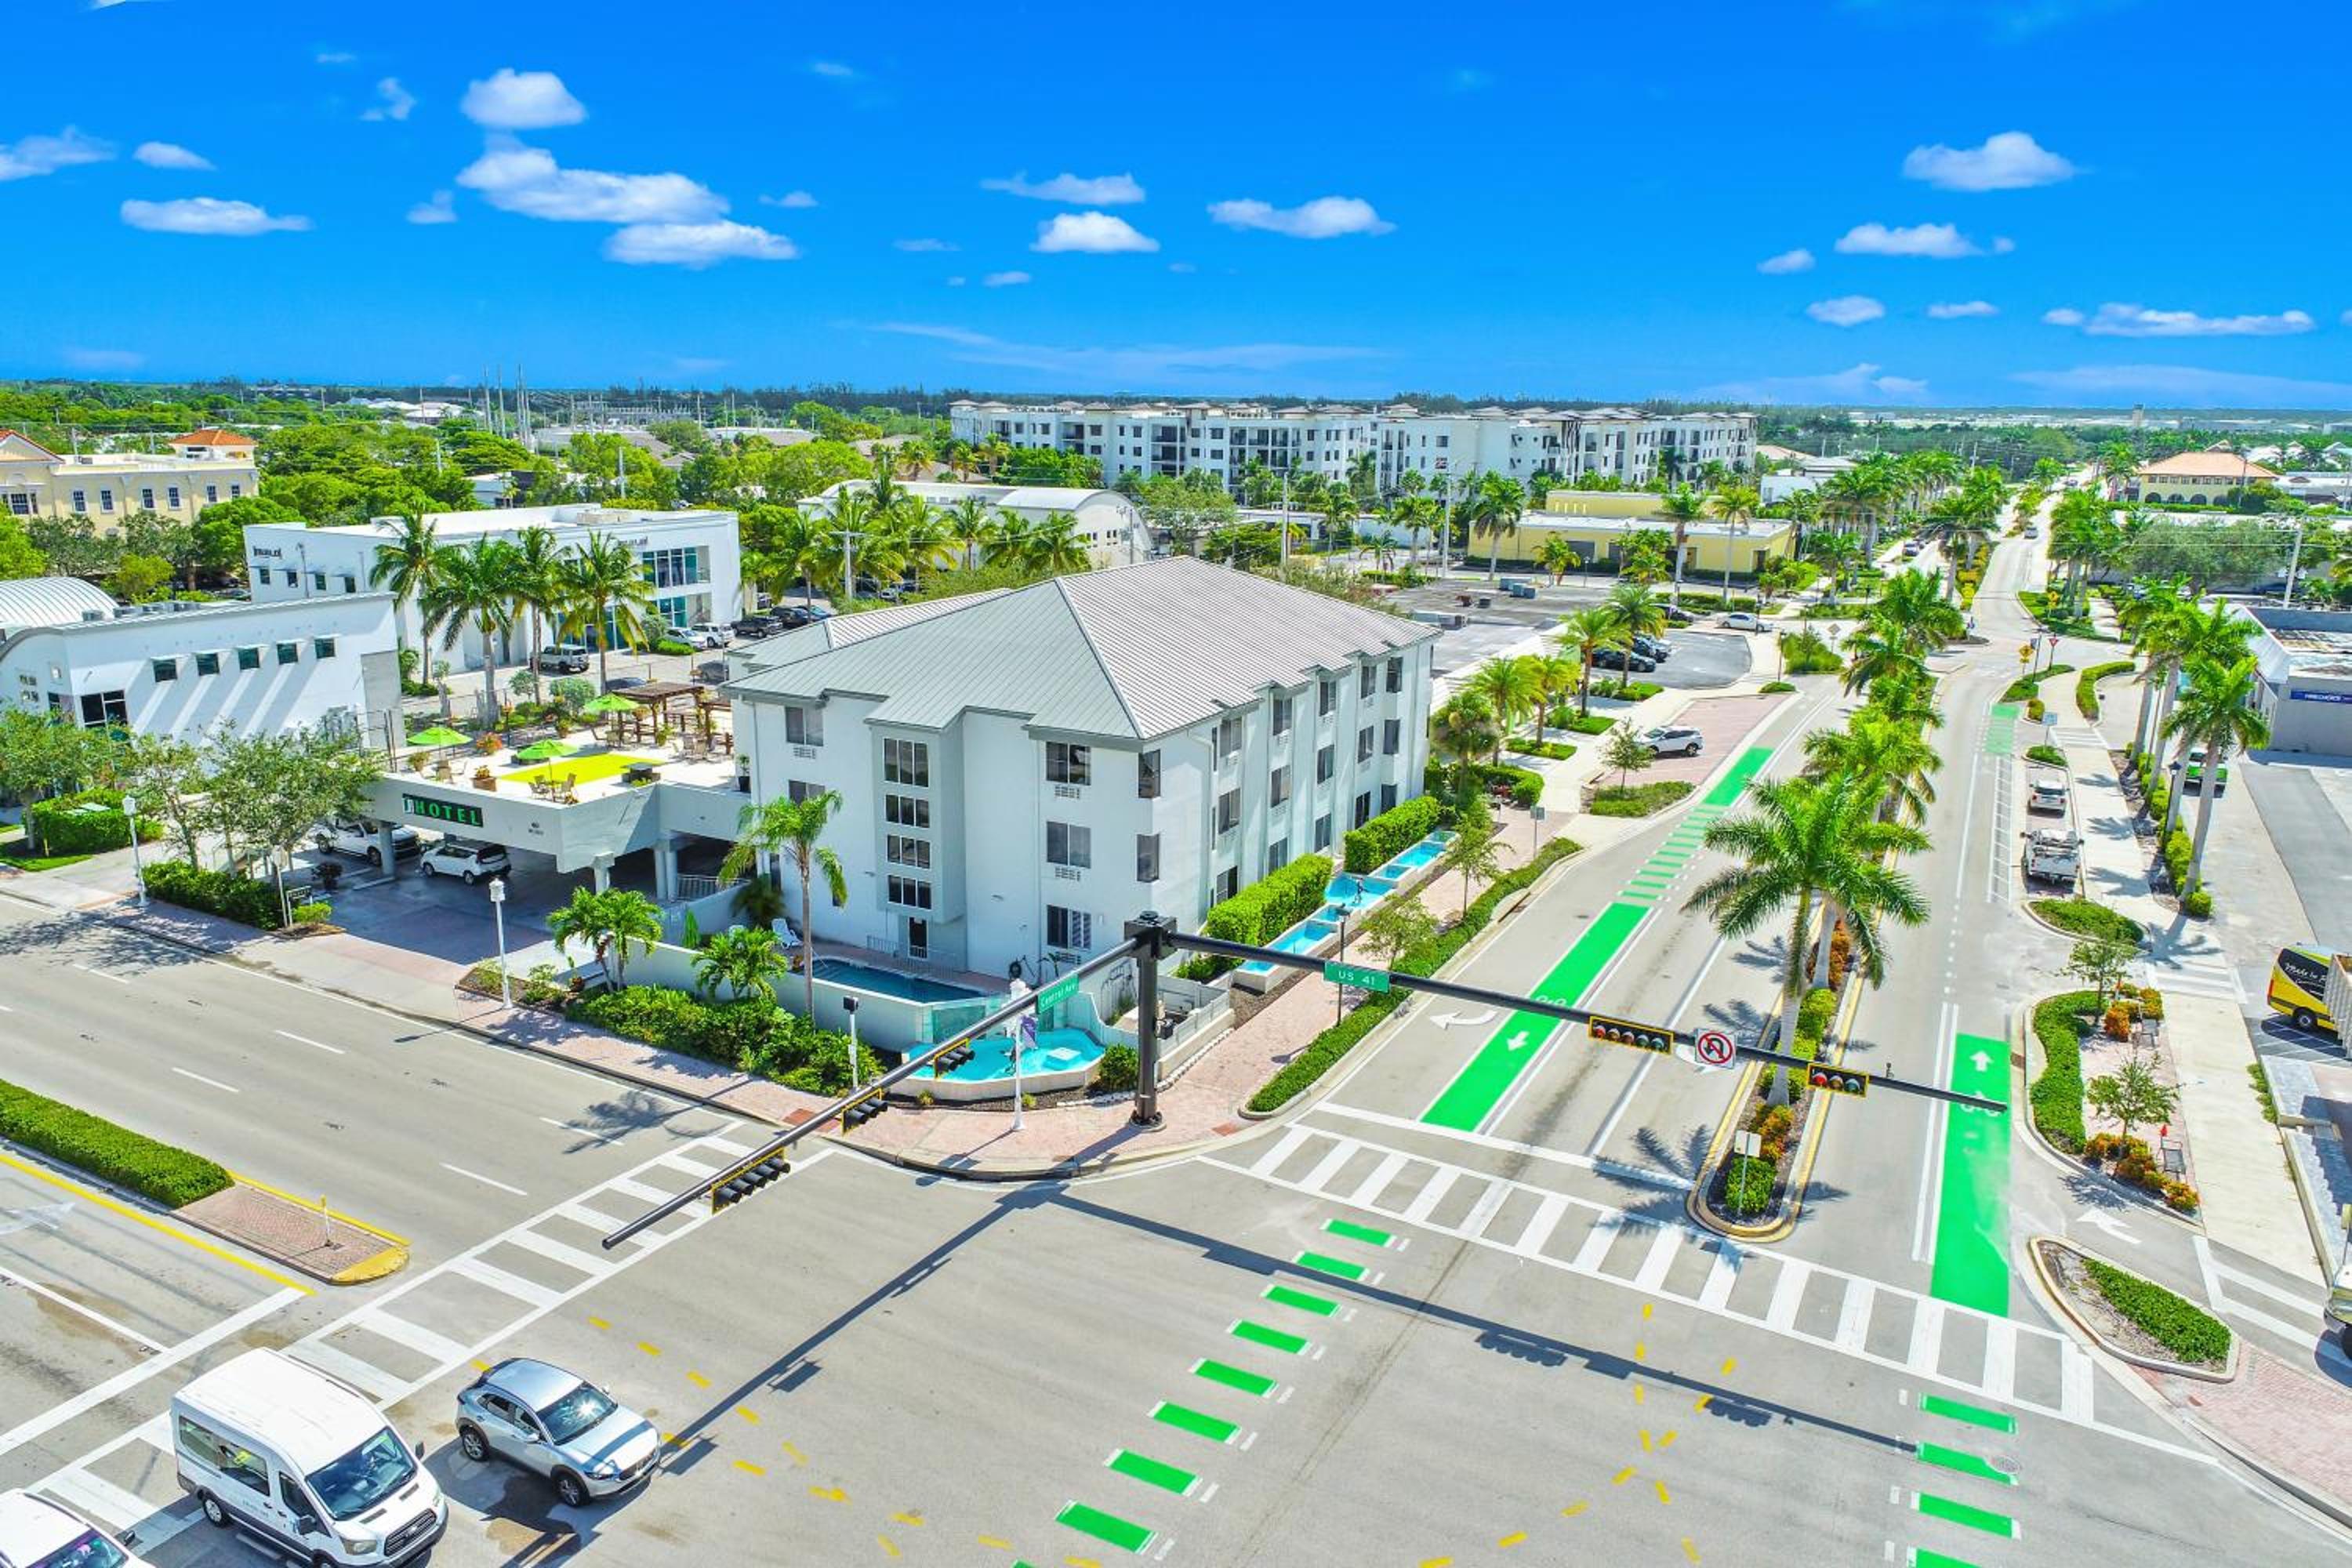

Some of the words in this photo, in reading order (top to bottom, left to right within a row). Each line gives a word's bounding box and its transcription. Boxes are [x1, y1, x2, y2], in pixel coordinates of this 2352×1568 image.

[415, 800, 481, 826] HOTEL
[1338, 971, 1354, 981] US
[1361, 975, 1374, 985] 41
